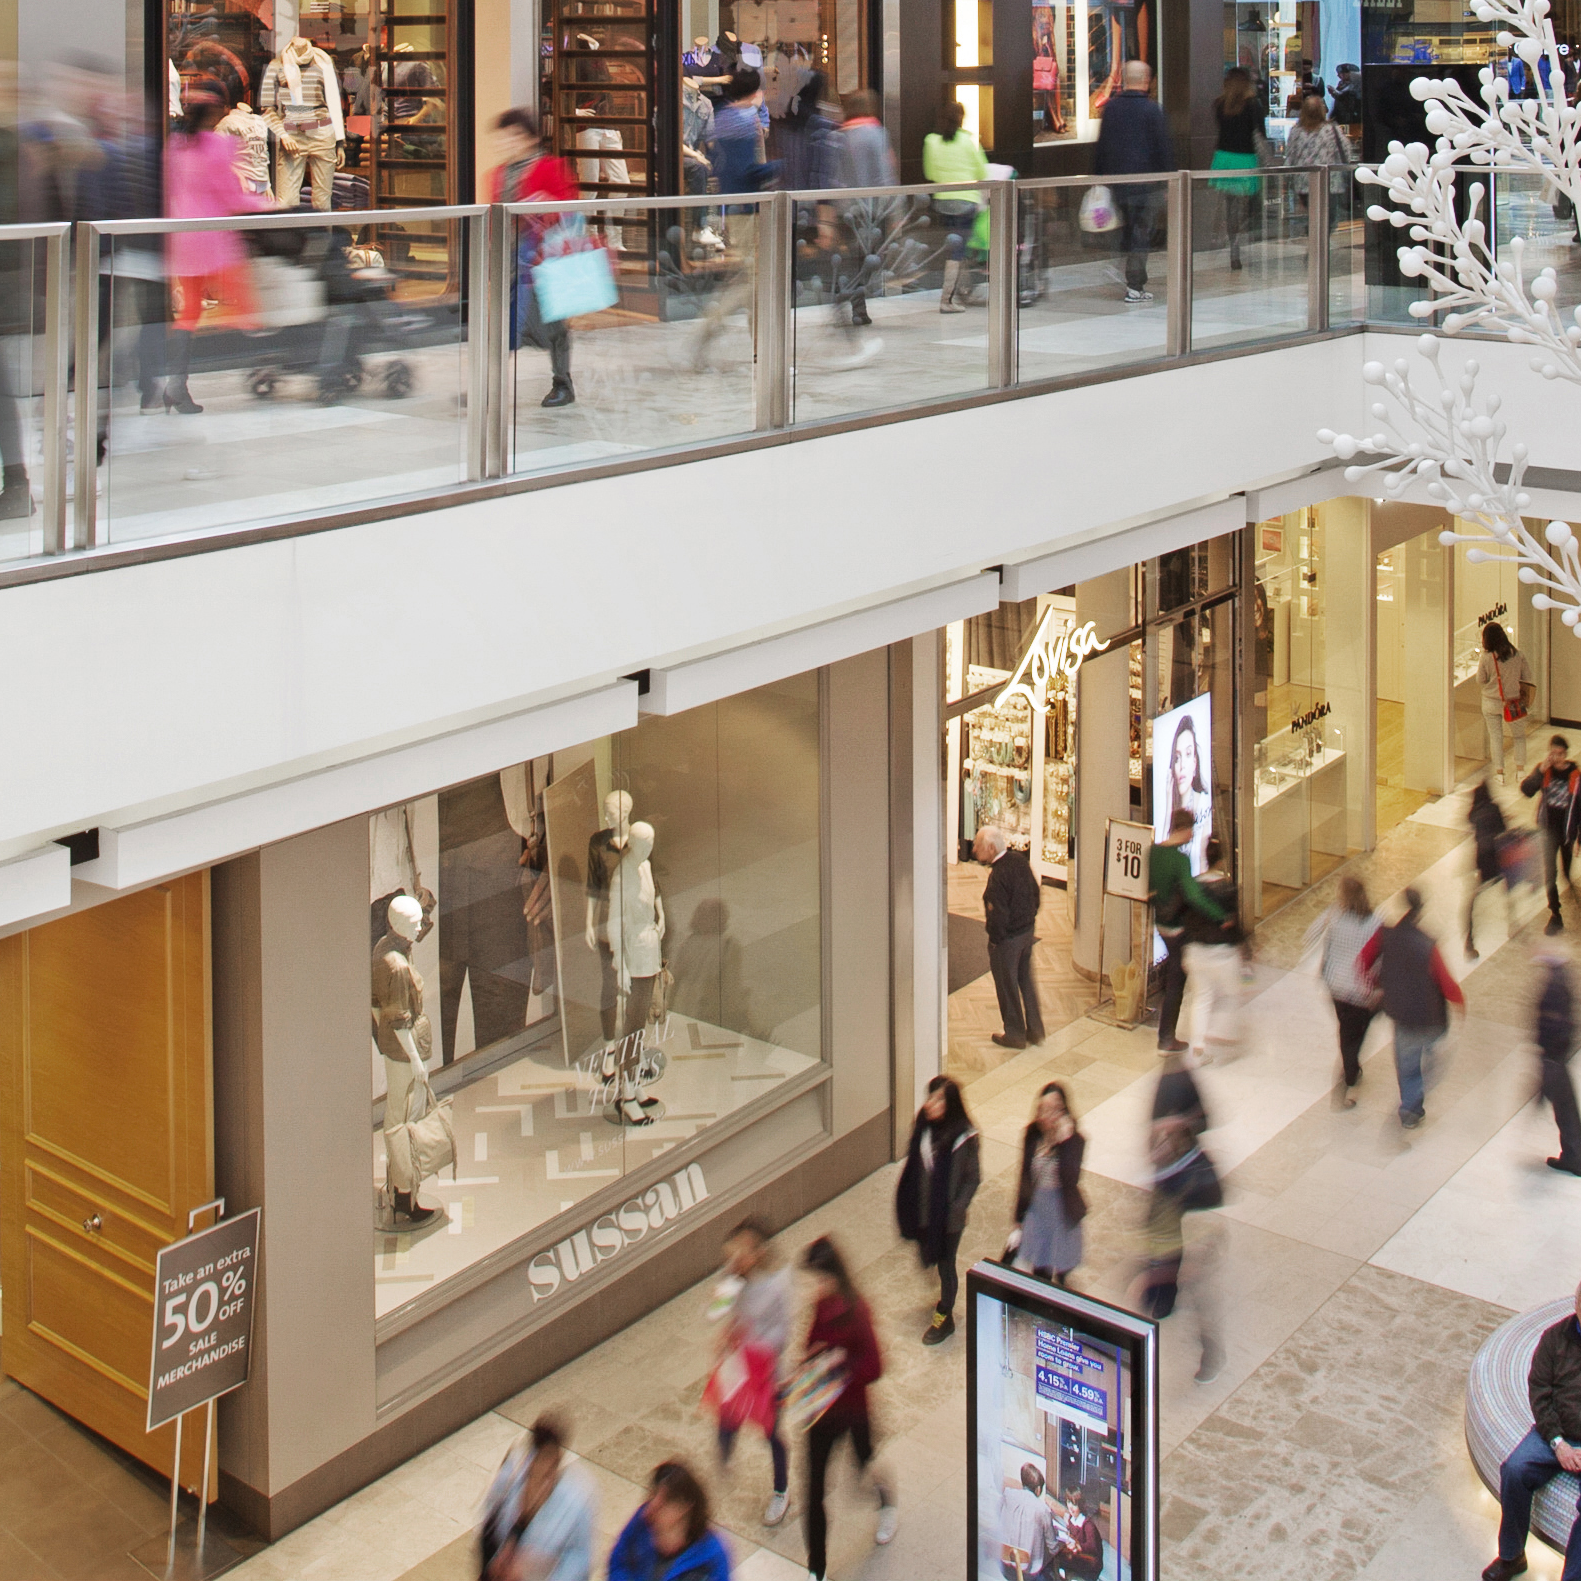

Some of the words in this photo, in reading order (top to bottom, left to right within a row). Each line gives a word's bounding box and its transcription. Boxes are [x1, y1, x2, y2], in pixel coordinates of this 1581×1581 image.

[994, 604, 1111, 713] Lovisa
[1116, 838, 1123, 852] 3
[1124, 839, 1142, 856] FOR
[1116, 852, 1142, 880] $10
[575, 1013, 675, 1083] NEUTRAL
[589, 1051, 663, 1116] TONES
[527, 1162, 711, 1304] sussan
[163, 1272, 194, 1296] Take
[196, 1262, 214, 1281] an
[216, 1245, 251, 1272] extra
[161, 1264, 247, 1351] 50%
[218, 1297, 245, 1322] OFF
[156, 1334, 247, 1391] MERCHANDISE
[188, 1330, 218, 1357] SALE
[1037, 1339, 1056, 1353] Home
[1056, 1346, 1076, 1361] Loans
[1075, 1354, 1090, 1365] give
[1089, 1360, 1103, 1371] you
[1037, 1351, 1055, 1363] room
[1054, 1356, 1062, 1365] to
[1056, 1336, 1080, 1352] Premier
